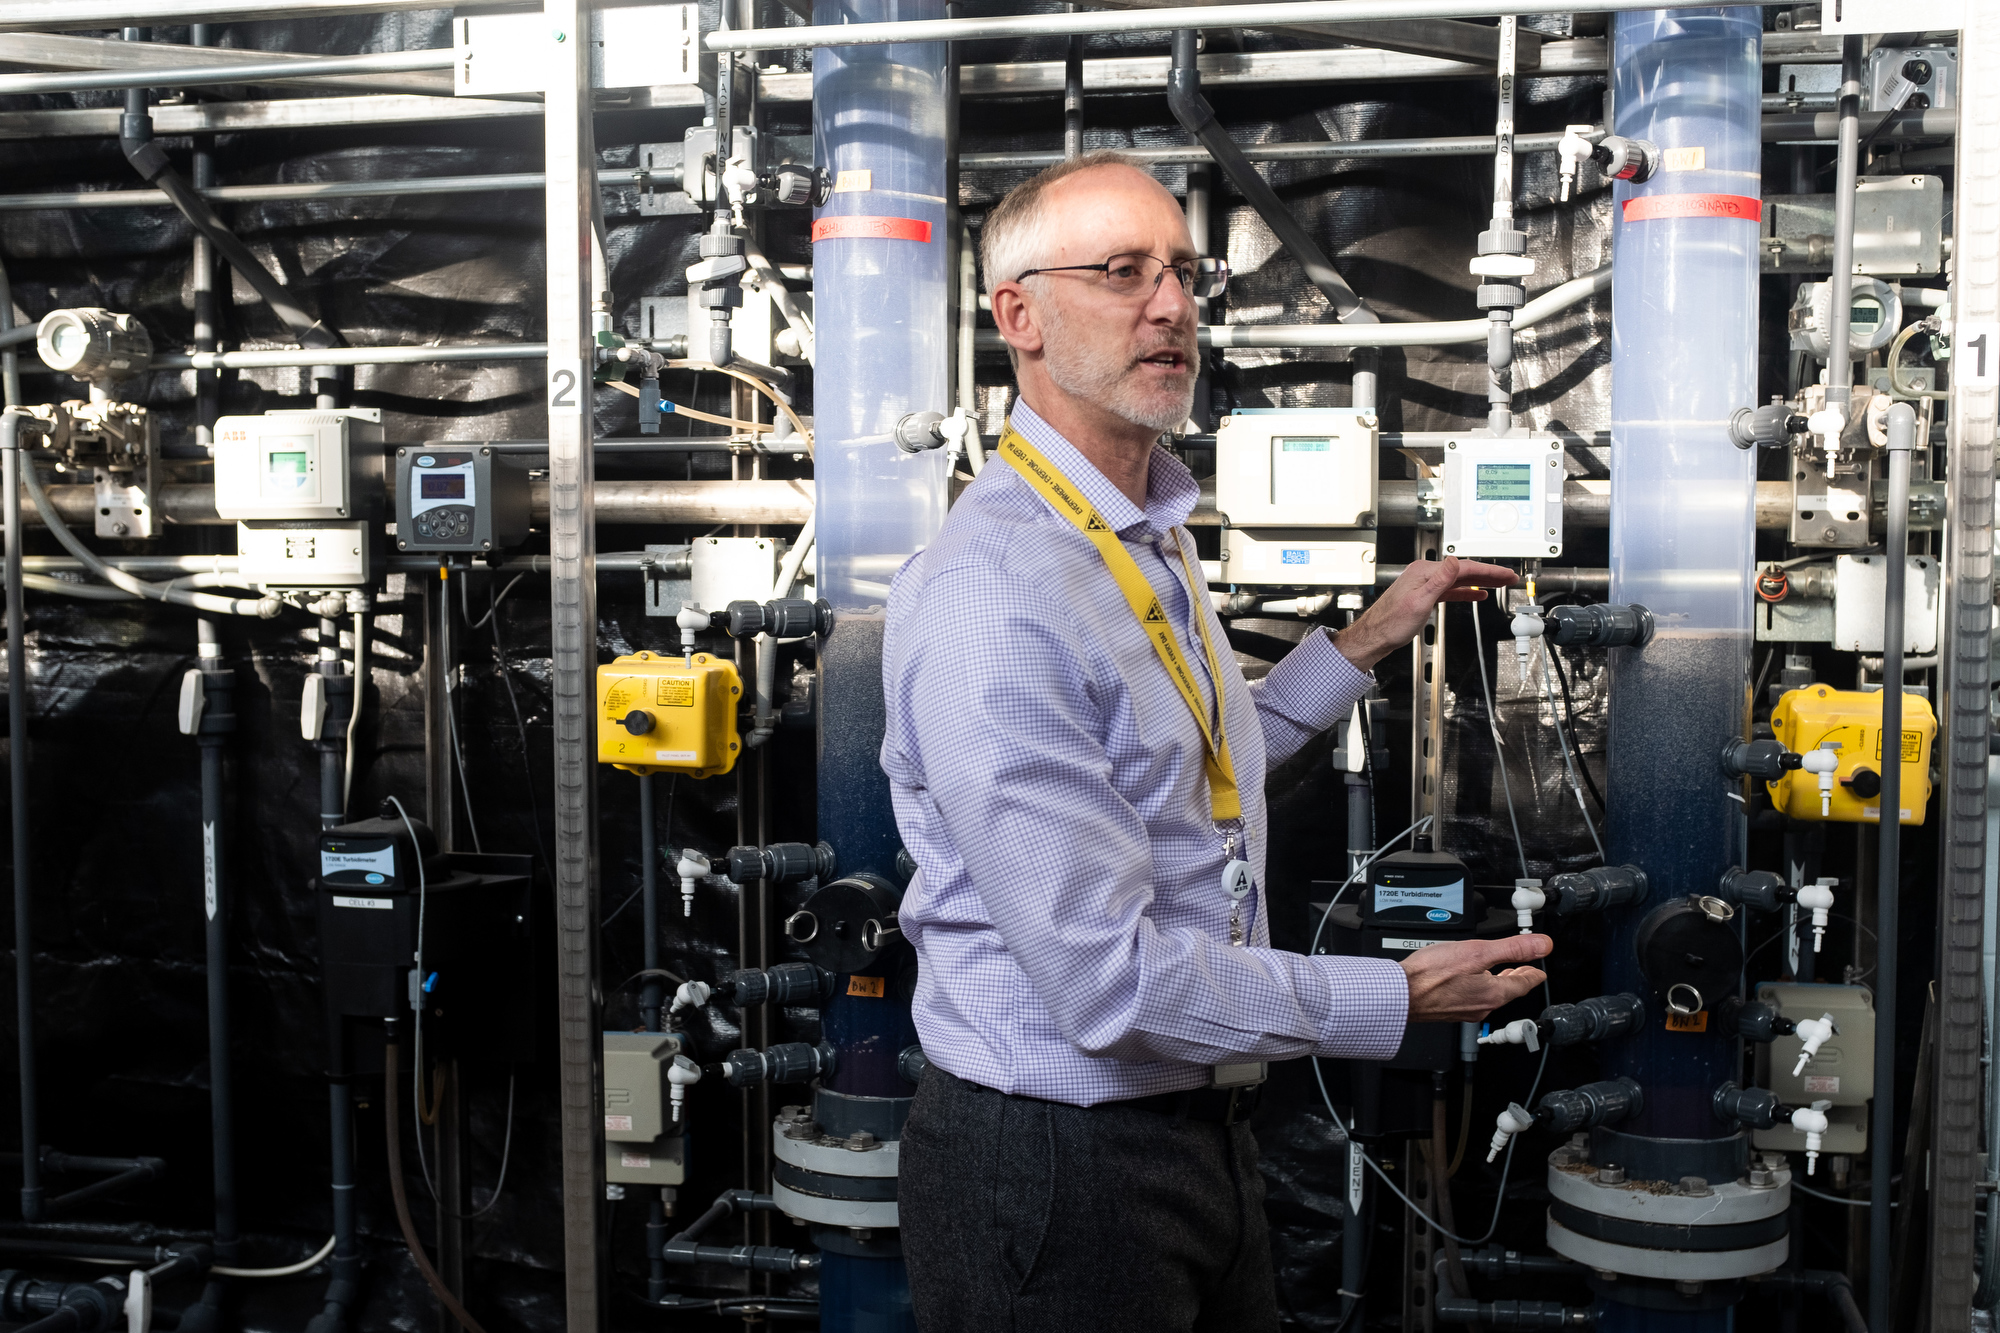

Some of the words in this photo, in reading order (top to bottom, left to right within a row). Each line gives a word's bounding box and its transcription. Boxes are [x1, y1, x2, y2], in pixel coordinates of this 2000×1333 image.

[1967, 333, 1986, 377] 1
[552, 369, 576, 407] 2
[222, 431, 247, 441] ABB
[618, 743, 626, 753] 2
[205, 855, 213, 905] DRAIN
[1401, 890, 1443, 898] Turbidimeter
[348, 898, 365, 907] CELL
[1402, 941, 1423, 949] CELL
